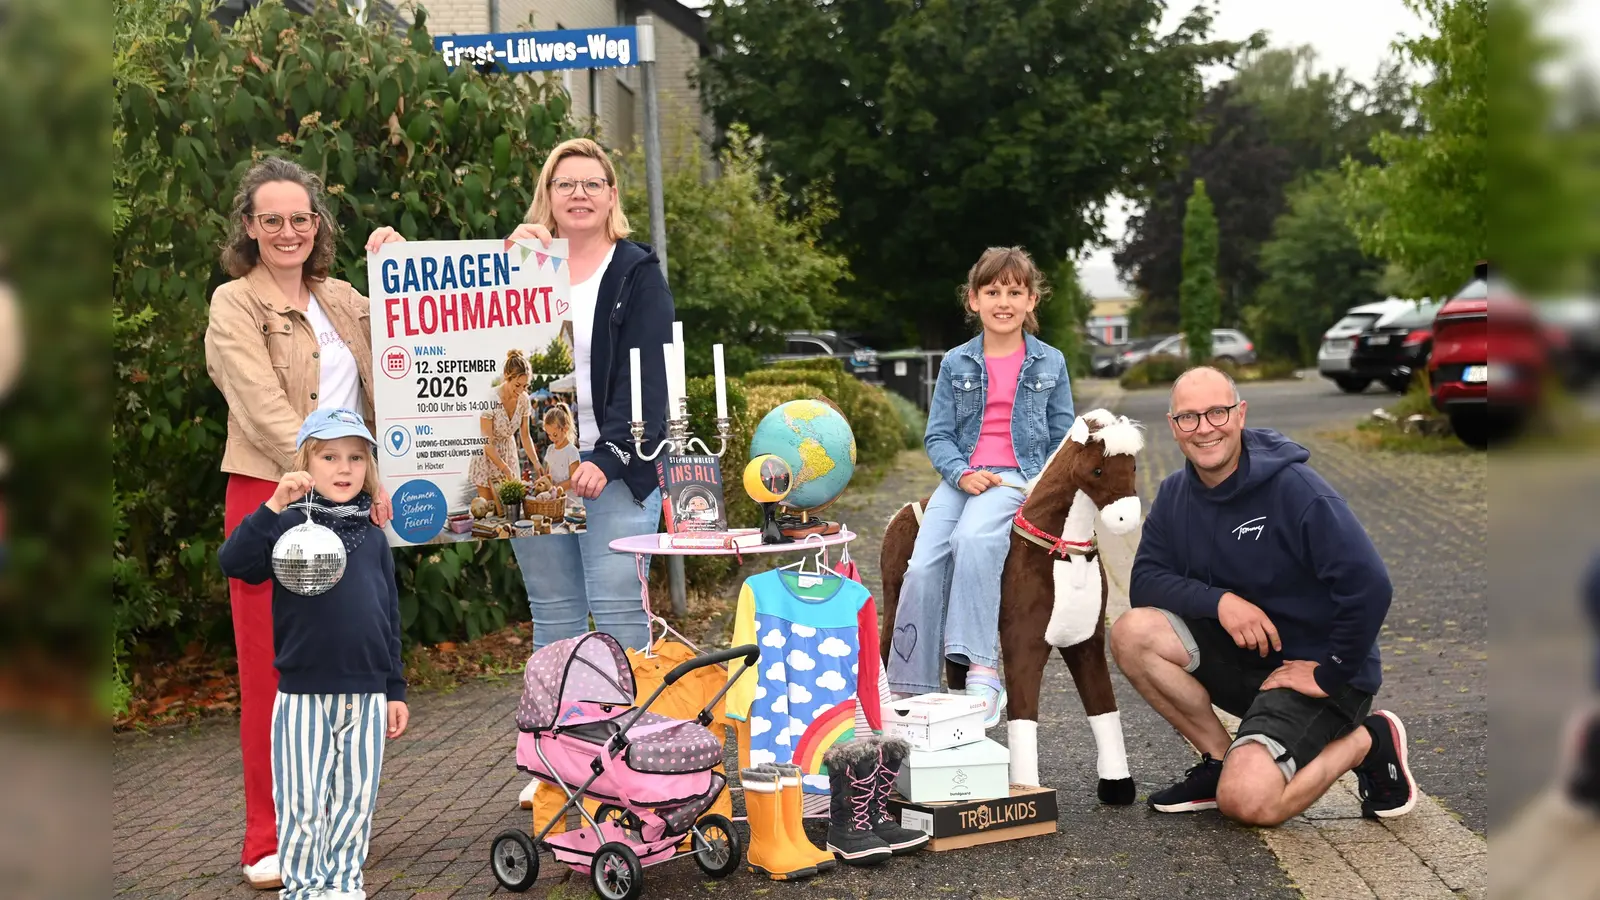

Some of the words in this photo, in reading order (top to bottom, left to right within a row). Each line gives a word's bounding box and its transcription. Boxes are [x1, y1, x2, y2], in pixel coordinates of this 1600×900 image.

[381, 252, 520, 294] GARAGEN-
[385, 286, 553, 338] FLOHMARKT
[414, 345, 447, 356] WANN:
[415, 361, 433, 374] 12.
[436, 359, 496, 374] SEPTEMBER
[416, 376, 468, 398] 2026
[417, 403, 439, 413] 10:00
[440, 403, 454, 412] Uhr
[456, 402, 467, 411] bis
[469, 401, 489, 411] 14:00
[415, 425, 433, 435] WO:
[416, 451, 429, 459] UND
[471, 448, 484, 456] WEG
[669, 456, 692, 464] STEPHEN
[670, 464, 692, 484] INS
[694, 464, 718, 485] ALL
[404, 513, 434, 529] Feiern!
[1232, 516, 1267, 540] Tommy
